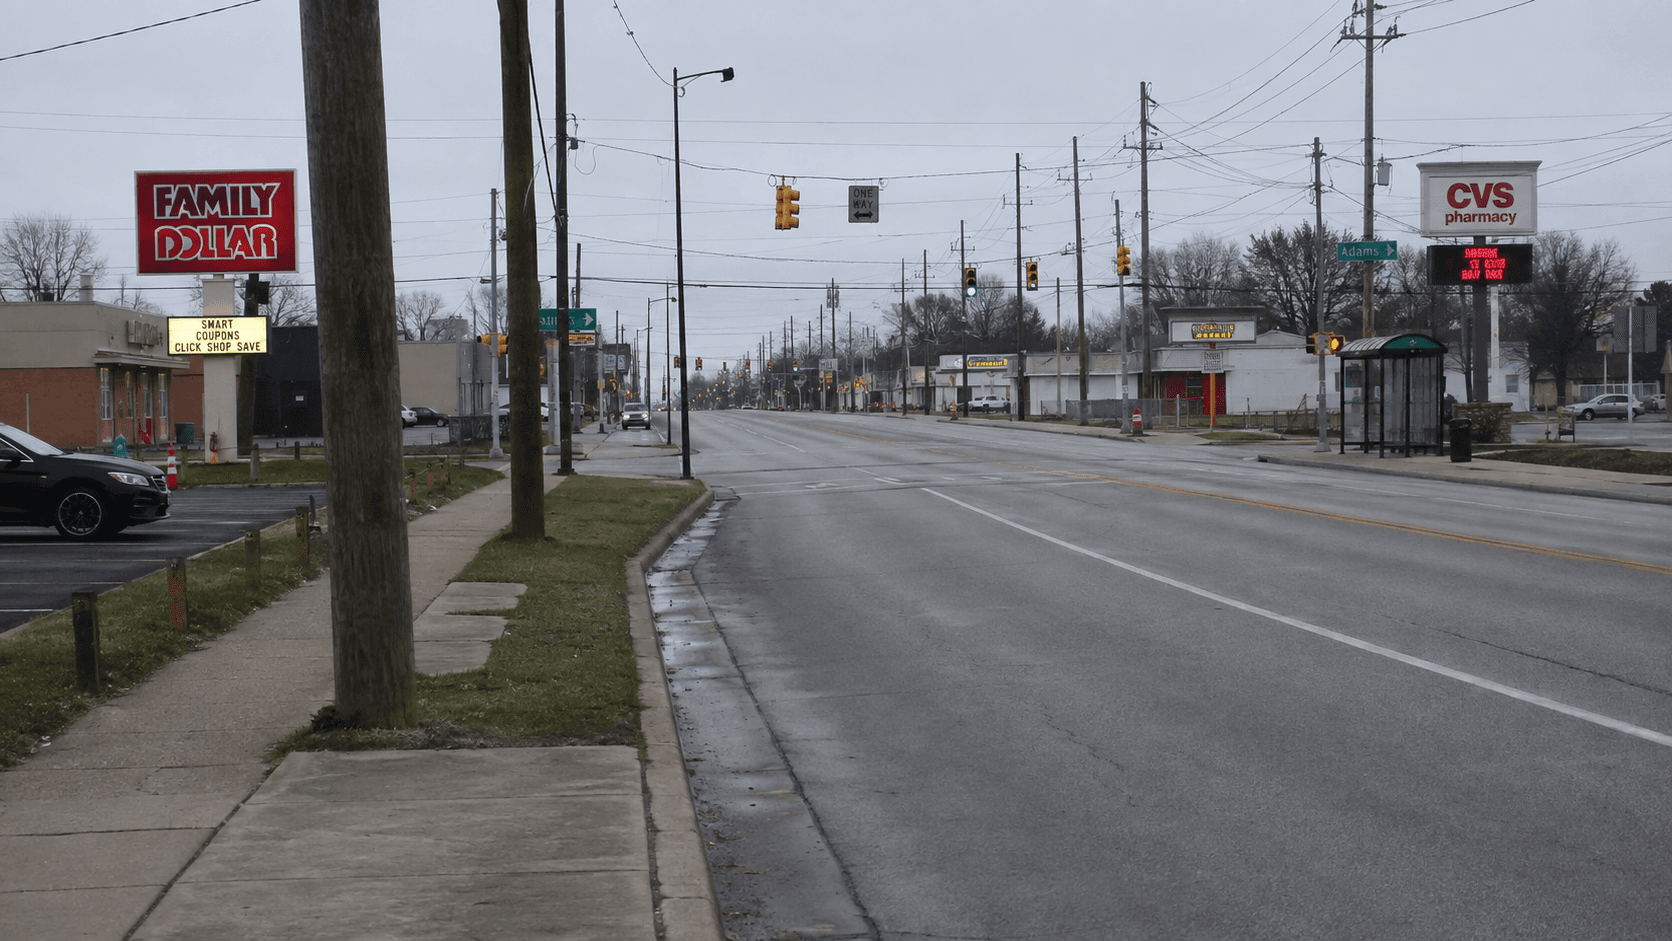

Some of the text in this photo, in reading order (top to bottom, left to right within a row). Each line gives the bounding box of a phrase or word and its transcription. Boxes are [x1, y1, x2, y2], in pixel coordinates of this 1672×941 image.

[853, 188, 873, 198] ONE
[1447, 182, 1514, 209] CVS
[153, 182, 281, 219] FAMILY
[1445, 211, 1517, 225] pharmacy
[154, 224, 278, 261] DOLLAR
[1341, 246, 1380, 257] Adams
[201, 319, 234, 329] SMART
[196, 331, 240, 341] COUPONS
[174, 341, 261, 352] CLICK SHOP SAVE
